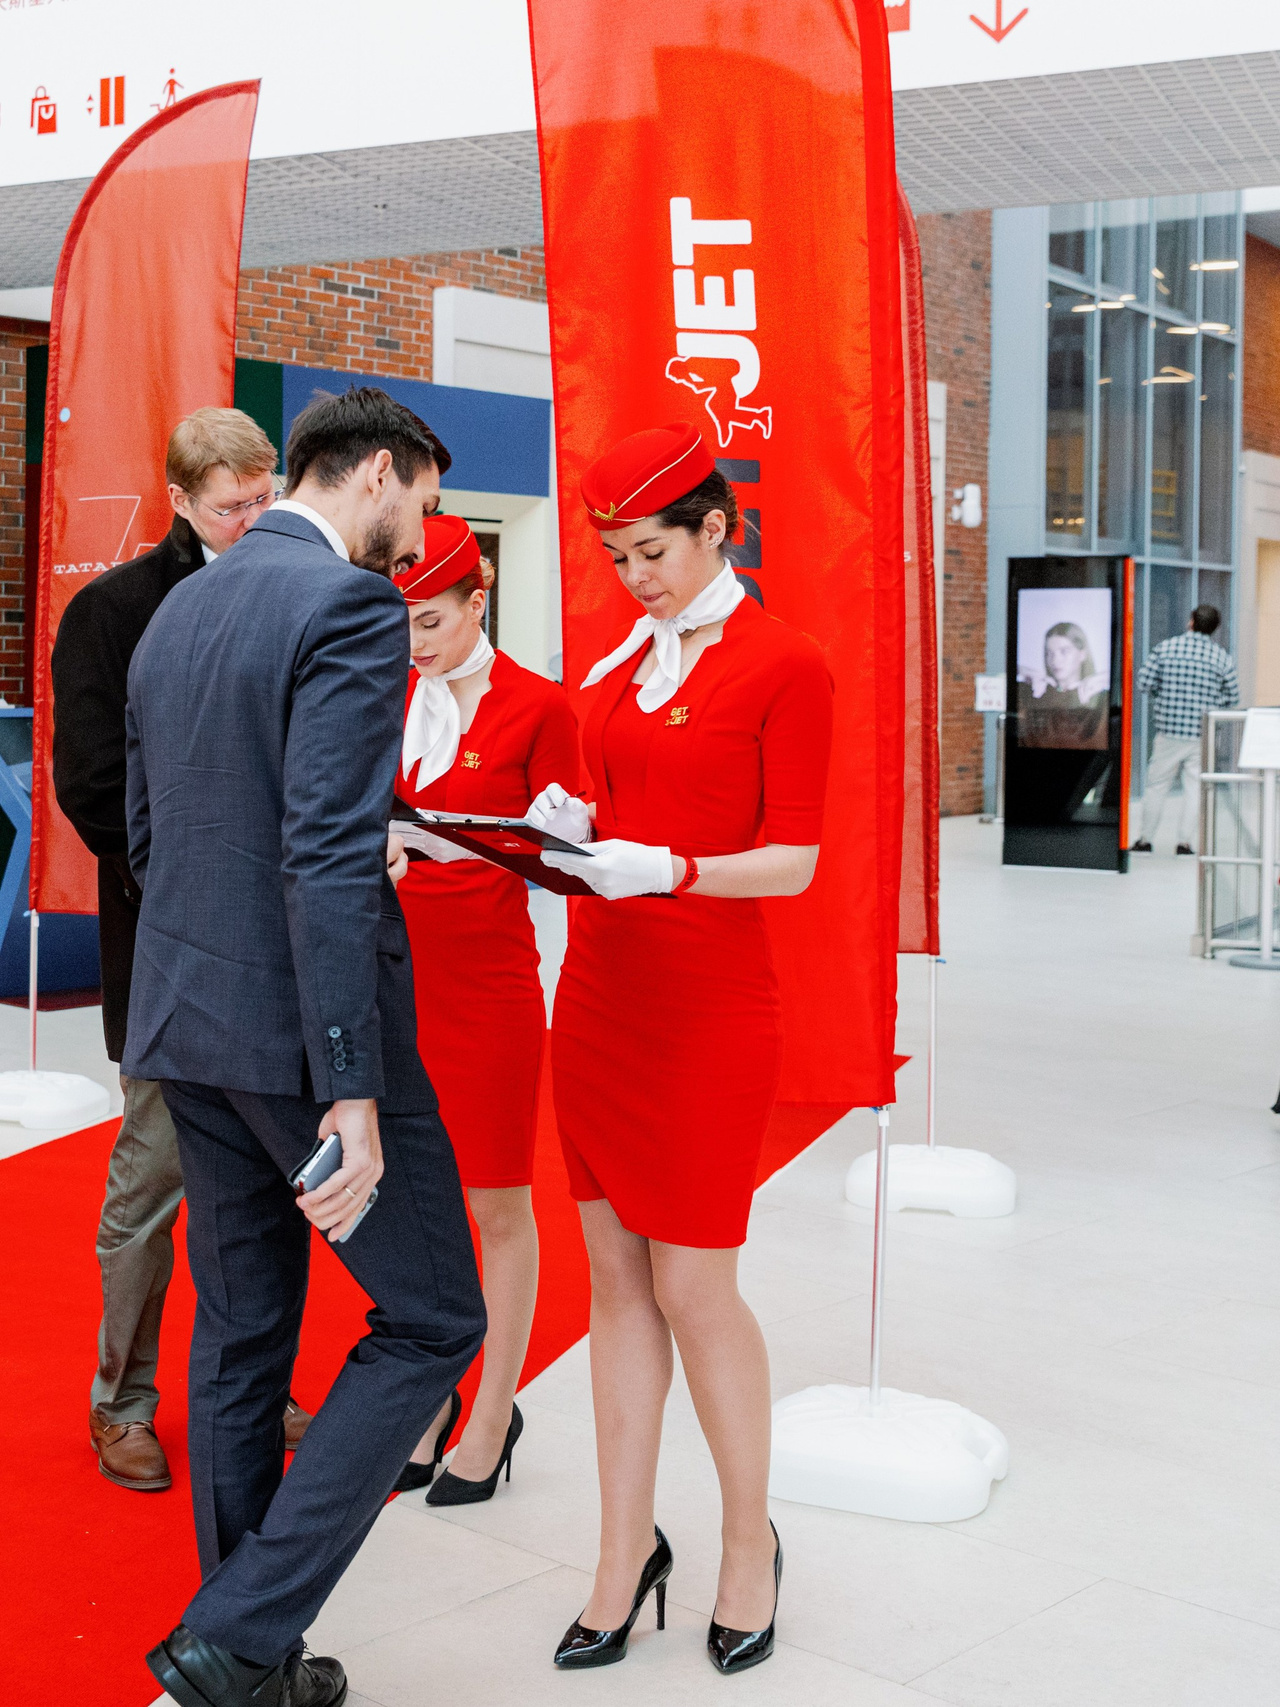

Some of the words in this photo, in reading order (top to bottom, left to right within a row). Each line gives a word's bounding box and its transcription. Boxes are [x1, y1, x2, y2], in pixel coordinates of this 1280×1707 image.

[669, 196, 761, 399] JET
[53, 561, 124, 575] TATA
[670, 706, 689, 717] GET
[669, 714, 690, 726] JET
[464, 750, 480, 762] GET
[464, 760, 481, 770] JET
